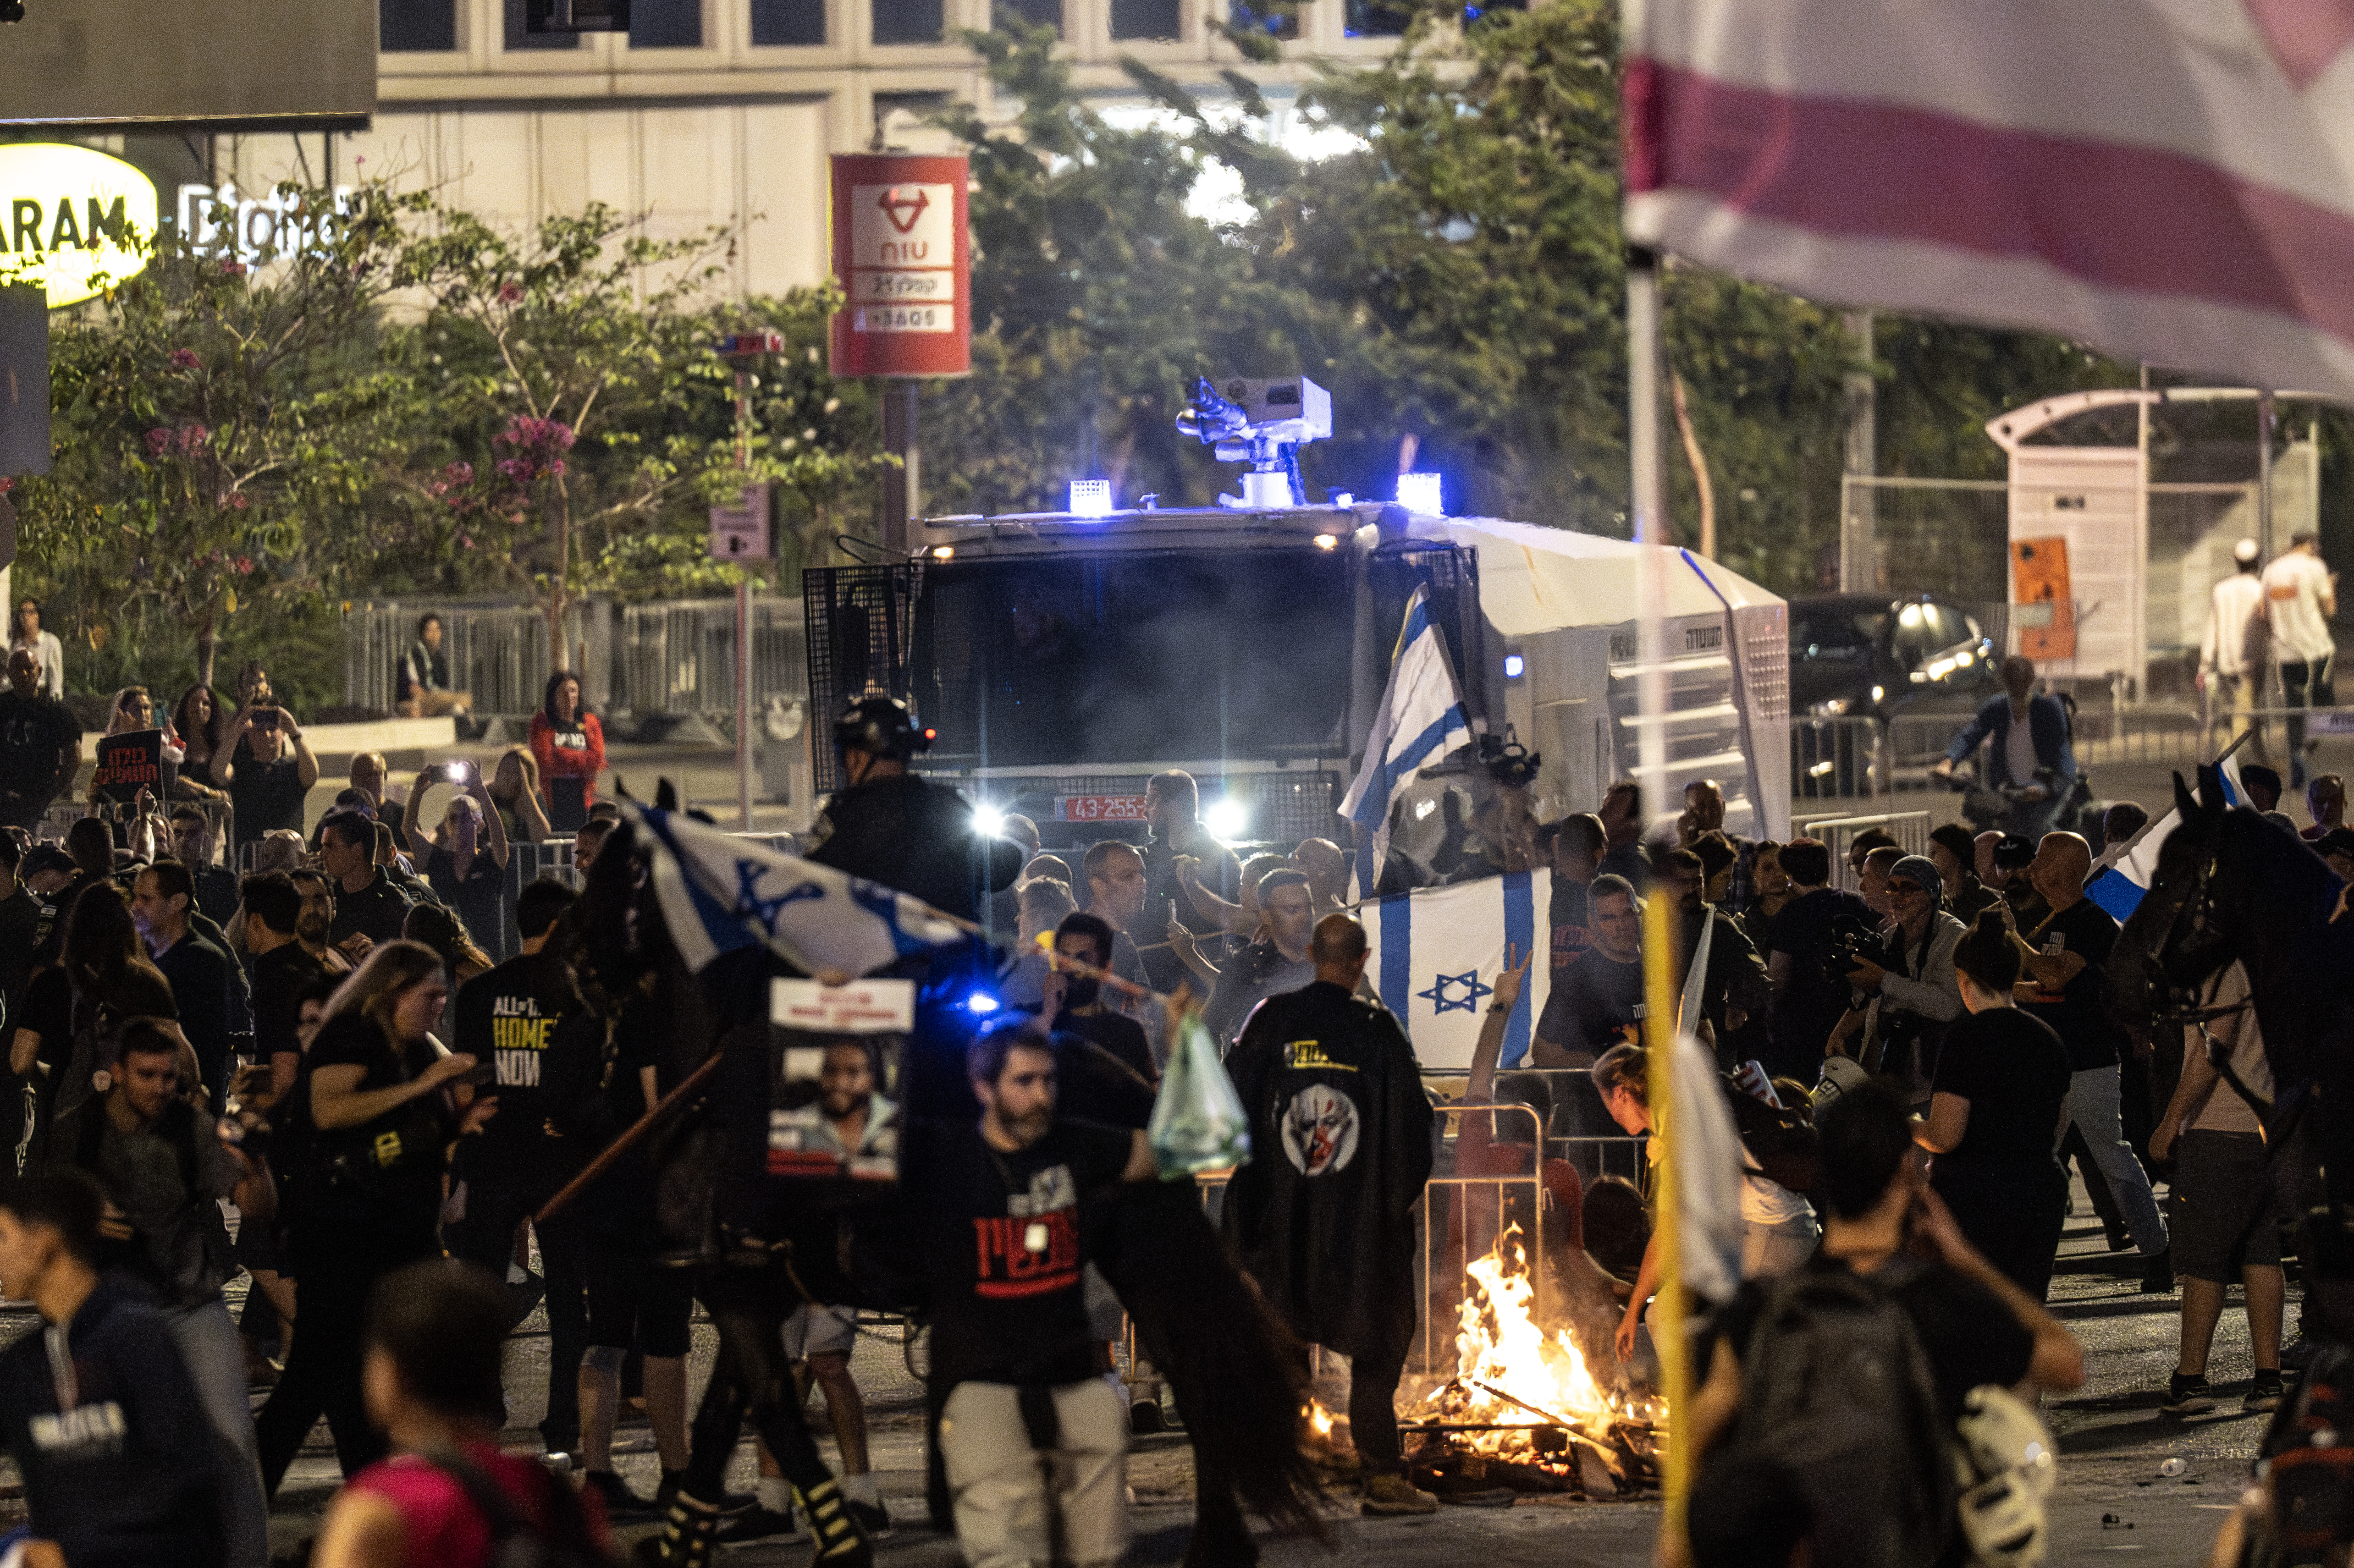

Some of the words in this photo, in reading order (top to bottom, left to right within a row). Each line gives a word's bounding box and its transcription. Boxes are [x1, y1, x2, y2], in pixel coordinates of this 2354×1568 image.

[0, 197, 126, 253] RAM
[1075, 797, 1146, 819] 43-255-
[492, 1017, 553, 1049] HOME
